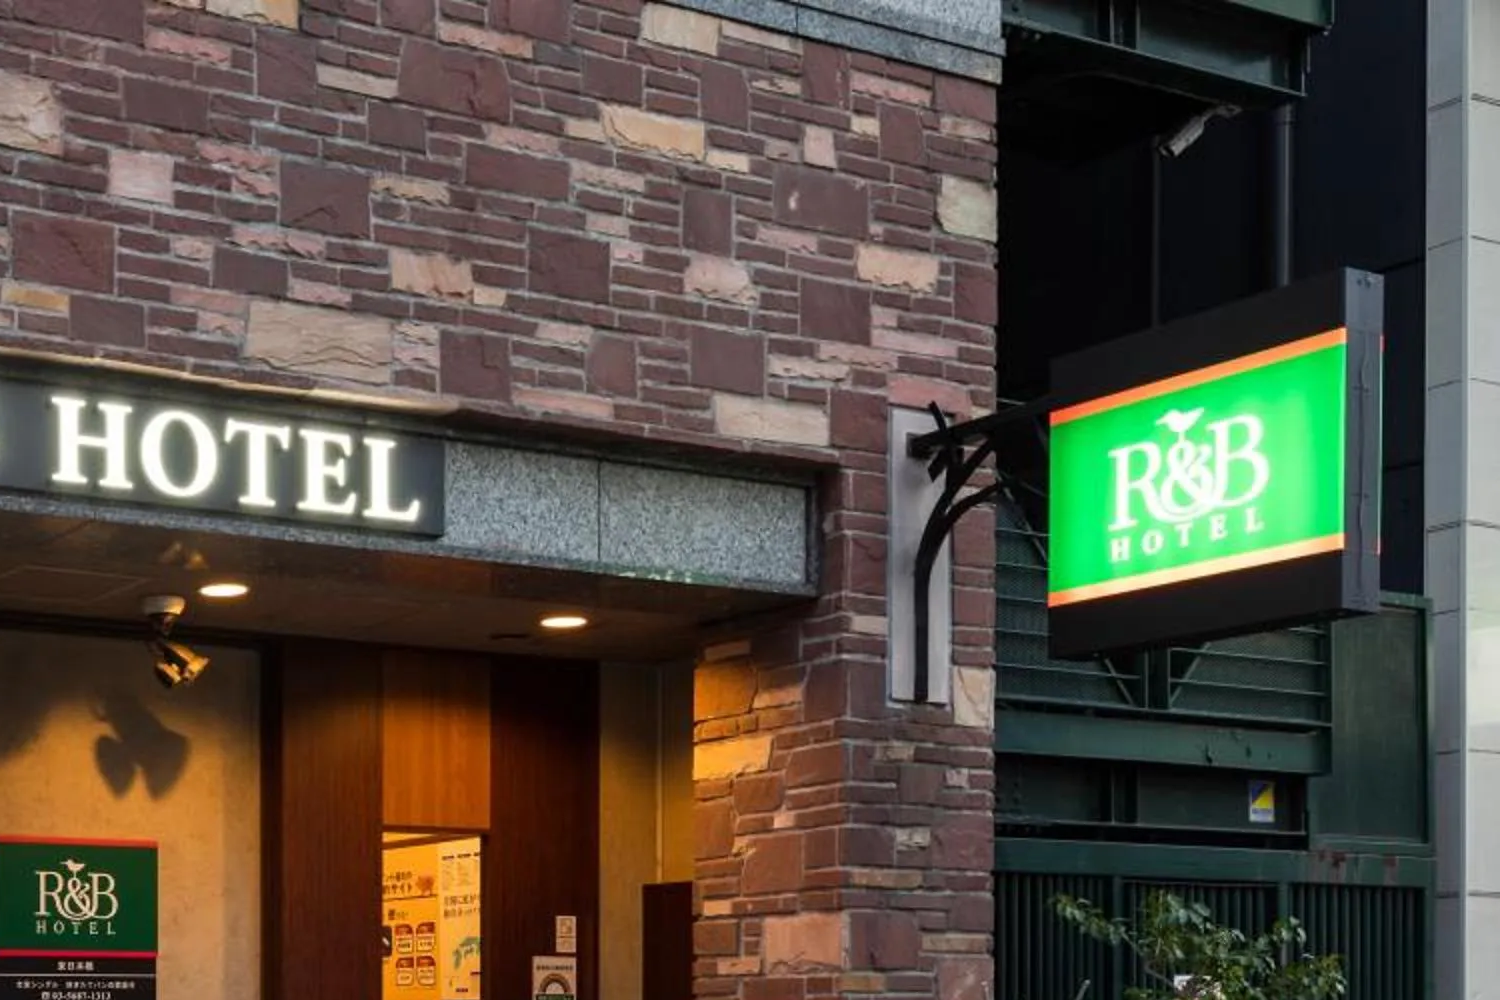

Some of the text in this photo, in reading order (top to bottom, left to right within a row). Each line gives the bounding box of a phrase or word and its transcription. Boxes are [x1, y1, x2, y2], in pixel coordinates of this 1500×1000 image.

[50, 396, 422, 524] HOTEL
[1107, 413, 1271, 532] R&B
[1109, 507, 1265, 564] HOTEL
[33, 870, 119, 921] R&B
[35, 920, 117, 936] HOTEL
